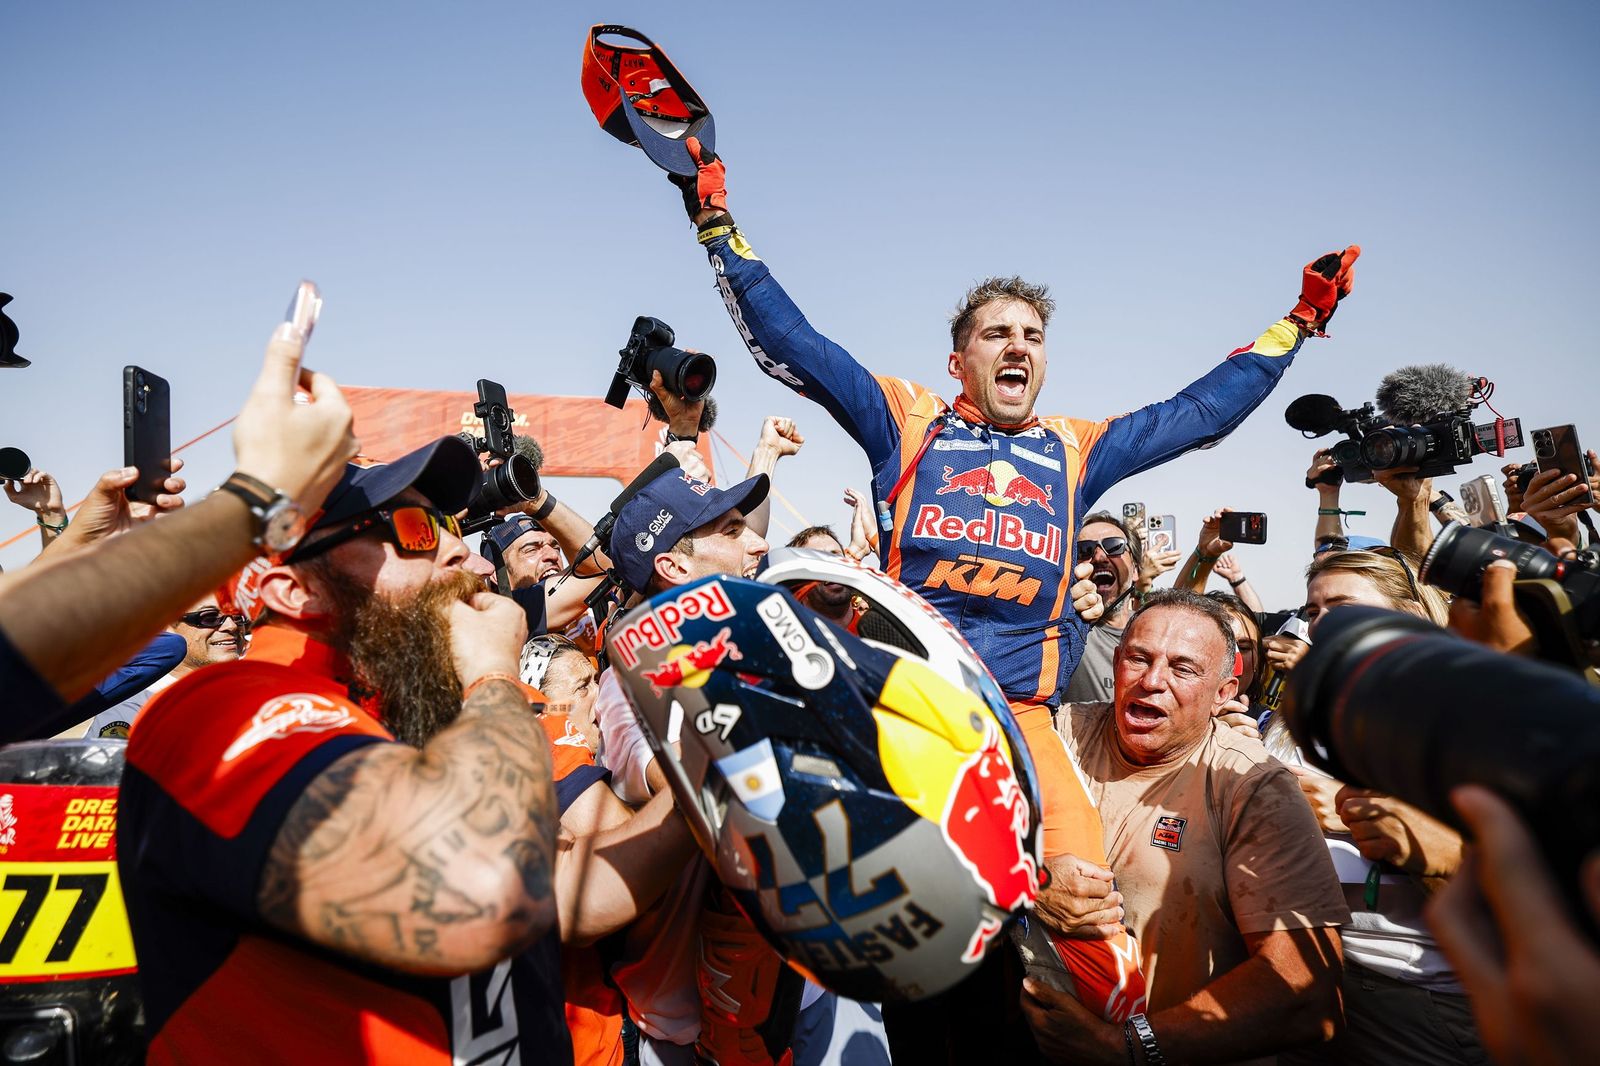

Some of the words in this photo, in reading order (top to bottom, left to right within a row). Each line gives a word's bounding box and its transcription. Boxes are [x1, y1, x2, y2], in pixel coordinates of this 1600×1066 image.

[649, 508, 670, 533] GMC
[923, 554, 1042, 606] KTM
[765, 601, 806, 653] GMC
[65, 798, 118, 814] DRE
[56, 832, 114, 849] LIVE
[745, 799, 910, 934] 77
[0, 873, 110, 965] 77
